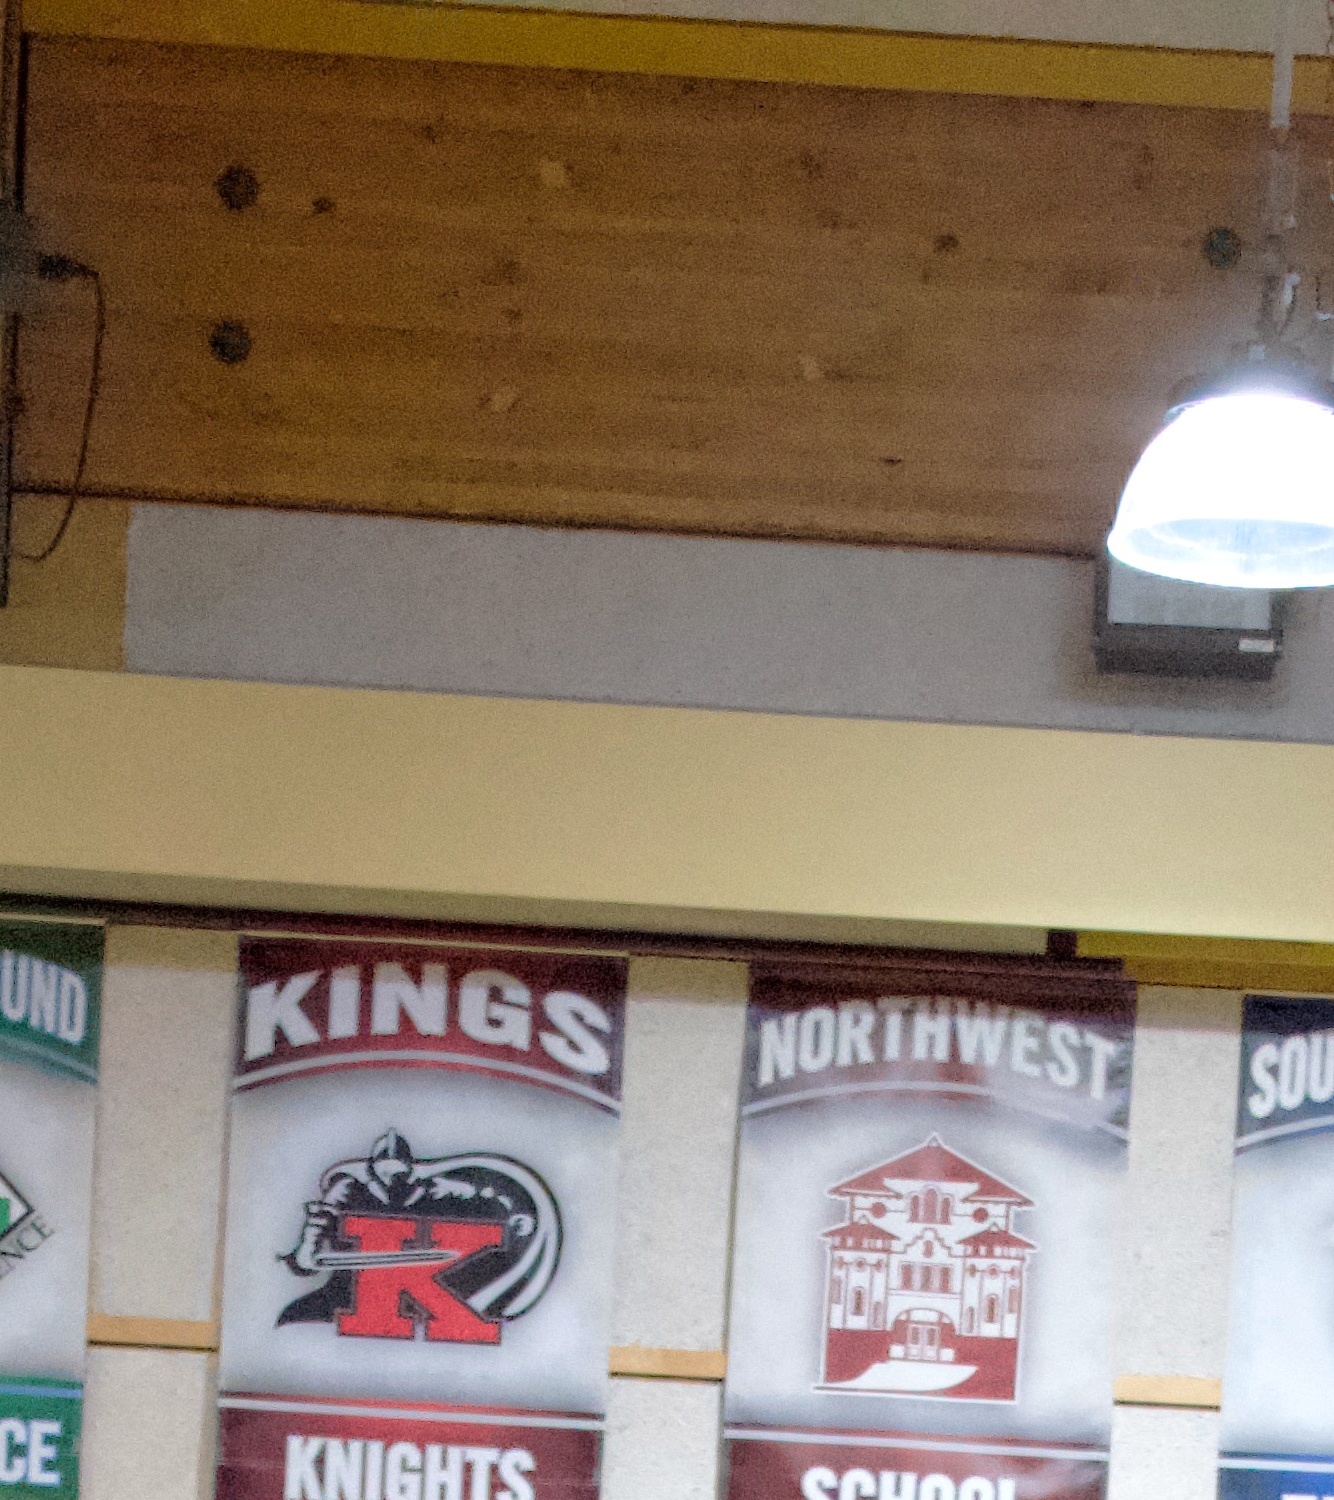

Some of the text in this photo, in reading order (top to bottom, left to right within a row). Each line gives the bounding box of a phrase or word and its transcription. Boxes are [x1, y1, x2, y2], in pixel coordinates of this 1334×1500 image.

[243, 956, 614, 1077] KINGS
[757, 998, 1119, 1102] NORTHWEST
[334, 1214, 503, 1345] K
